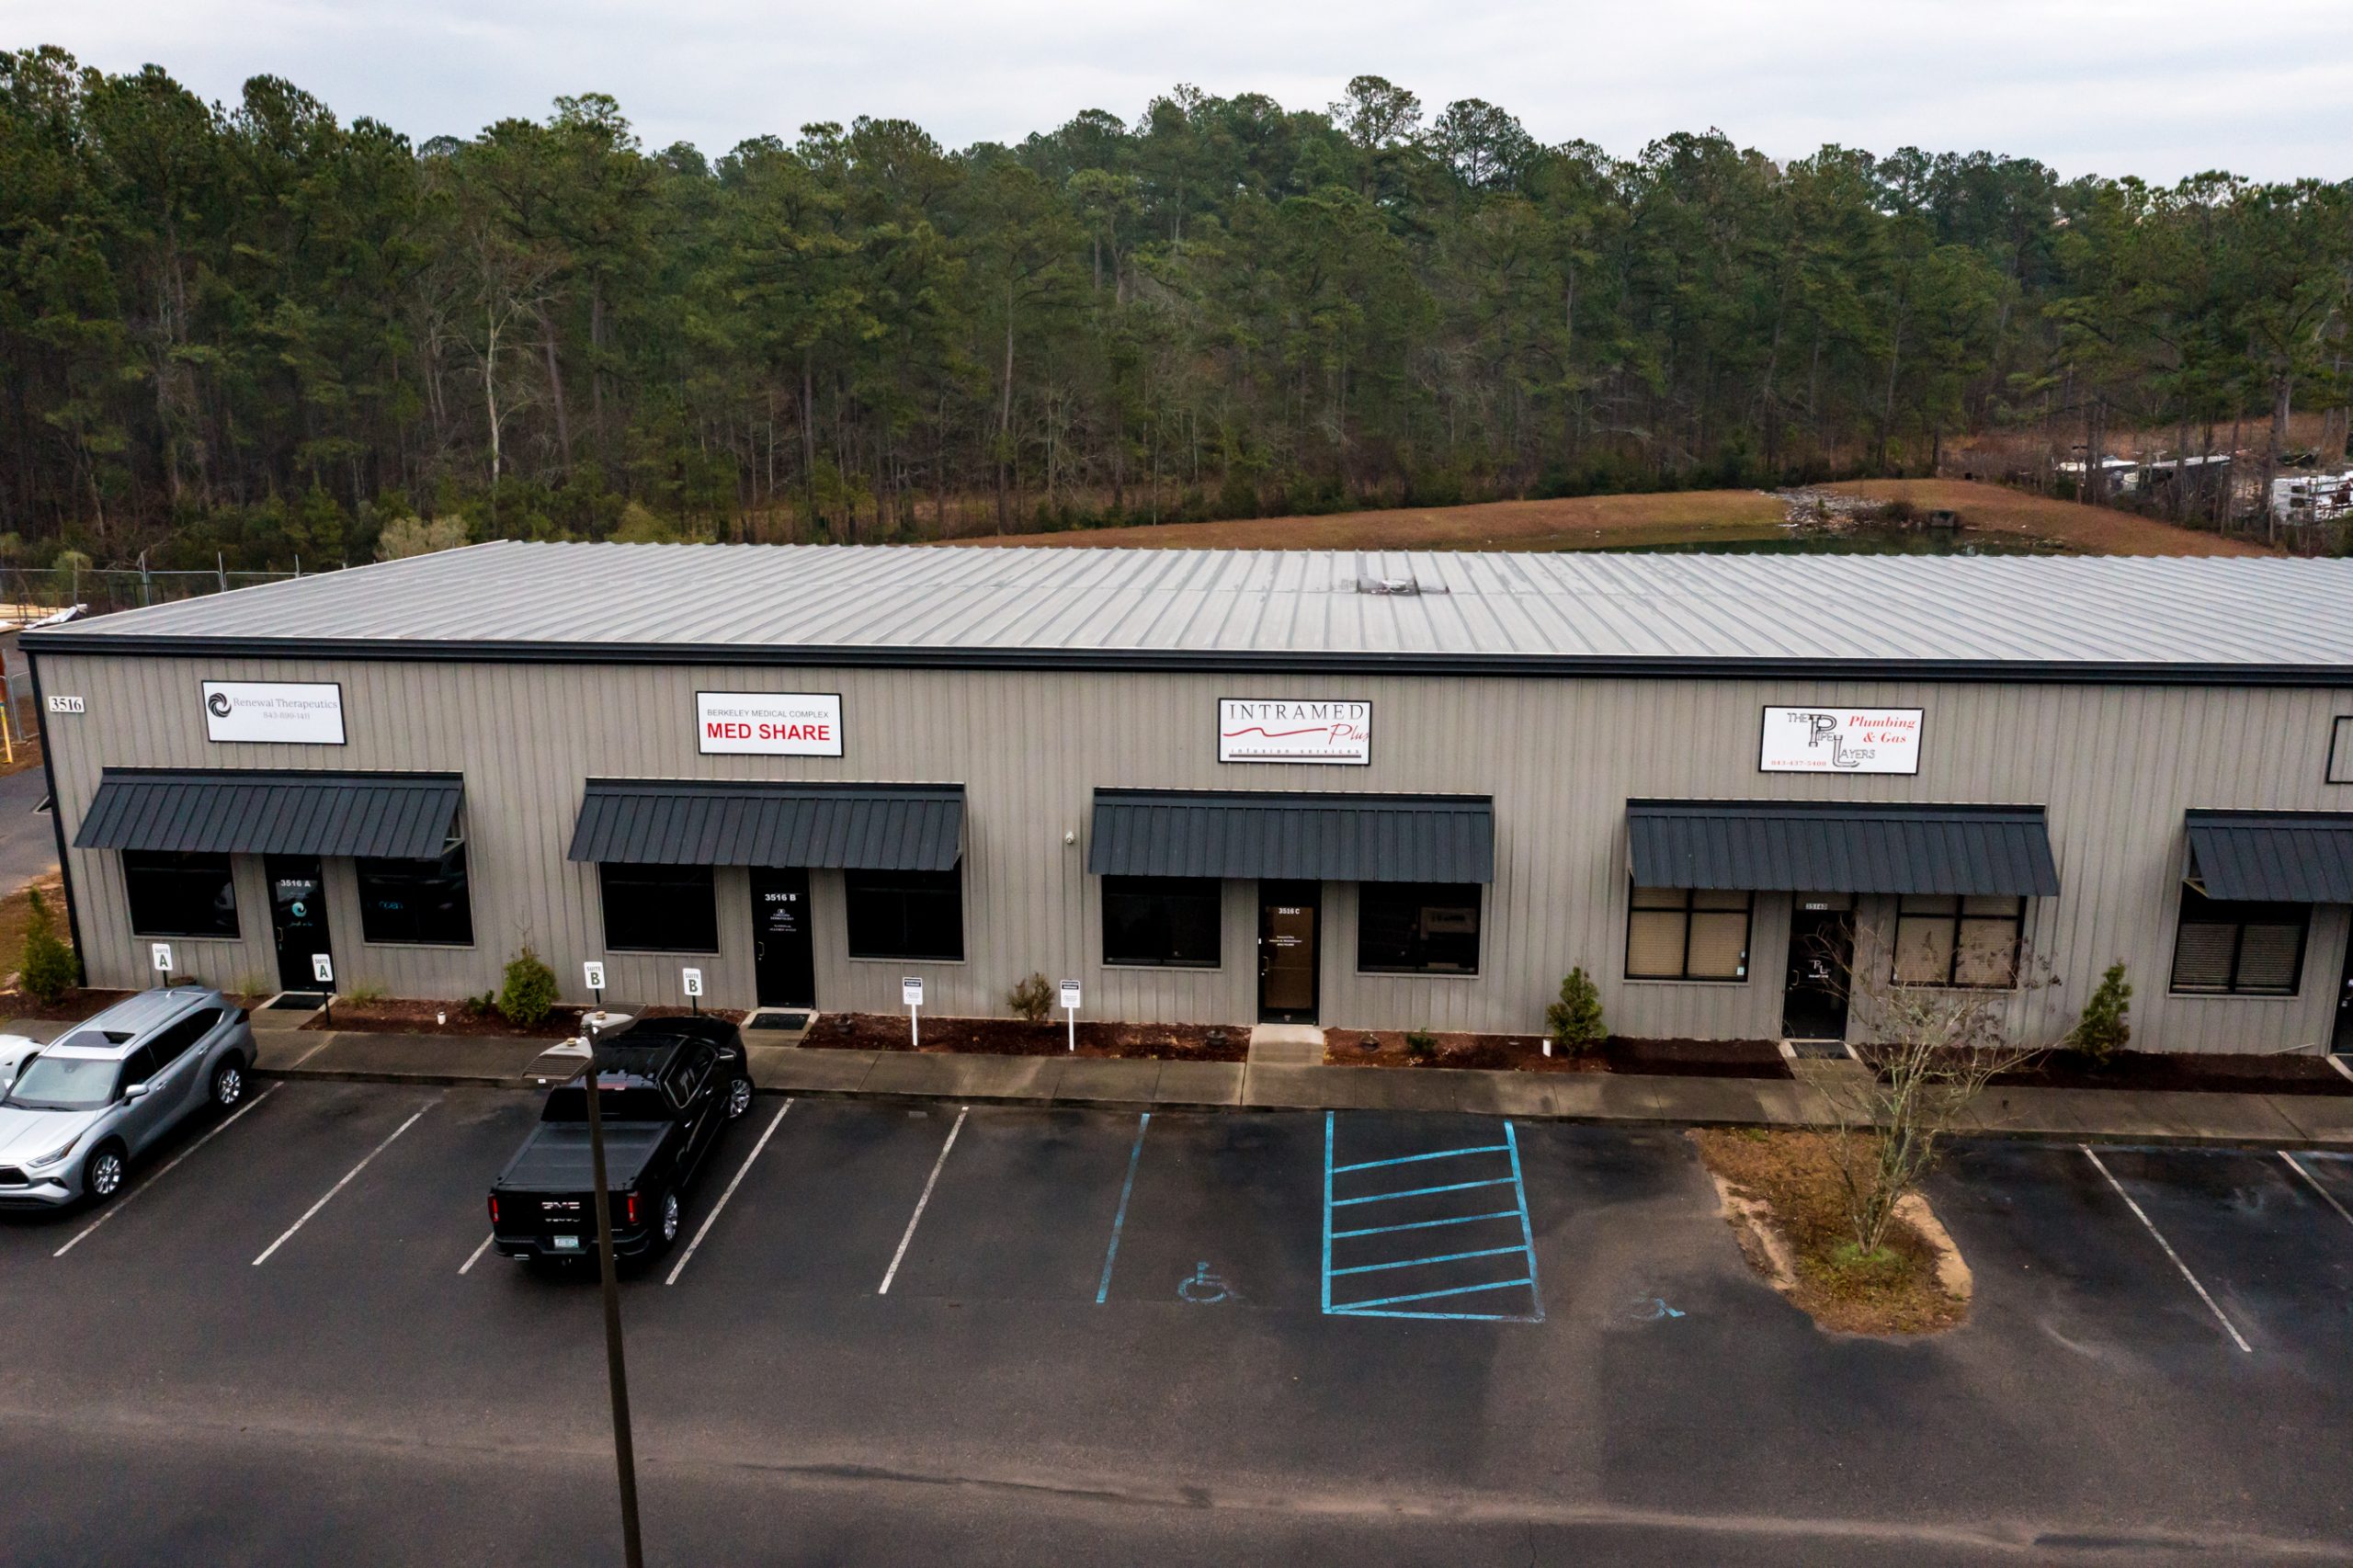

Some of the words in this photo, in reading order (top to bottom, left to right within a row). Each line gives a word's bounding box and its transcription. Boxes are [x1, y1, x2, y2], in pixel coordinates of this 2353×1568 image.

[51, 698, 82, 710] 3516
[233, 698, 274, 708] Renewal
[275, 698, 338, 710] Therapeutics
[707, 709, 750, 718] BERKELEY
[751, 710, 788, 719] MEDICAL
[789, 710, 829, 719] COMPLEX
[1229, 703, 1364, 721] INTRAMED
[1787, 712, 1810, 723] THE
[1848, 715, 1916, 730] Plumbing
[707, 722, 752, 739] MED
[758, 723, 831, 741] SHARE
[1328, 722, 1370, 745] Plus
[1863, 733, 1876, 743] &
[1881, 732, 1907, 744] Gas
[280, 879, 302, 888] 3516
[304, 880, 312, 888] A
[765, 893, 788, 902] 3516
[790, 893, 797, 902] B
[159, 953, 169, 968] A
[319, 964, 330, 979] A
[590, 971, 601, 985] B
[688, 978, 699, 993] B
